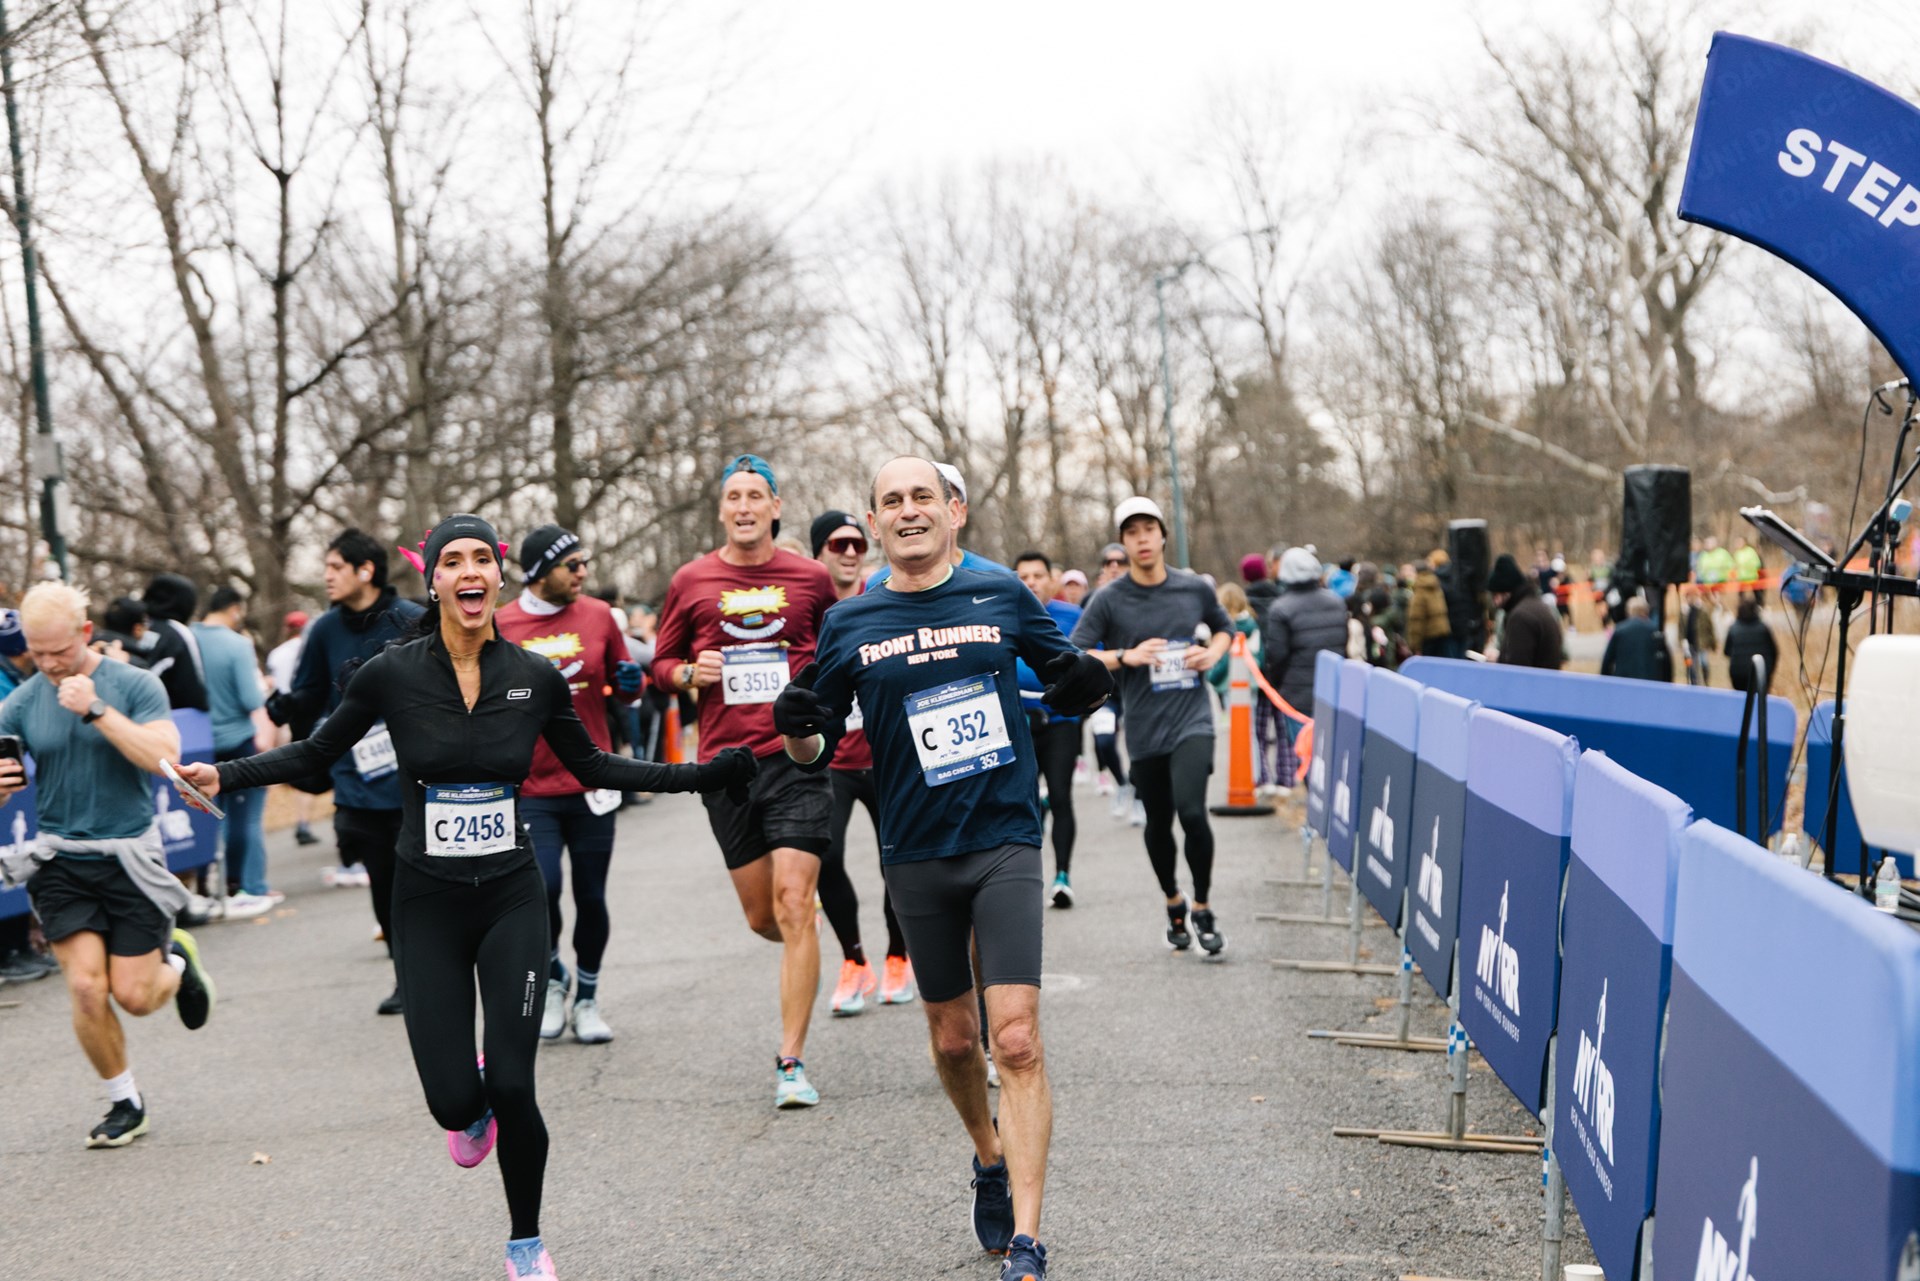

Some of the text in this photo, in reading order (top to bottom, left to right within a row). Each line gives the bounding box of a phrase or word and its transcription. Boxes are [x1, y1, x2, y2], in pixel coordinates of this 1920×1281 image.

[1777, 127, 1920, 229] STEP
[858, 624, 1002, 666] FRONT RUNNERS
[907, 647, 959, 665] NEW YORK
[728, 671, 780, 693] C 3519
[916, 698, 931, 709] JOE
[930, 687, 973, 705] KLEINERMAN
[921, 709, 989, 751] C 352
[937, 752, 1000, 780] BAG CHECK 352
[434, 812, 505, 843] C 2458
[1475, 923, 1520, 1018] NYRR
[1501, 1013, 1521, 1043] RUNNERS
[1572, 1028, 1615, 1167] NYRR
